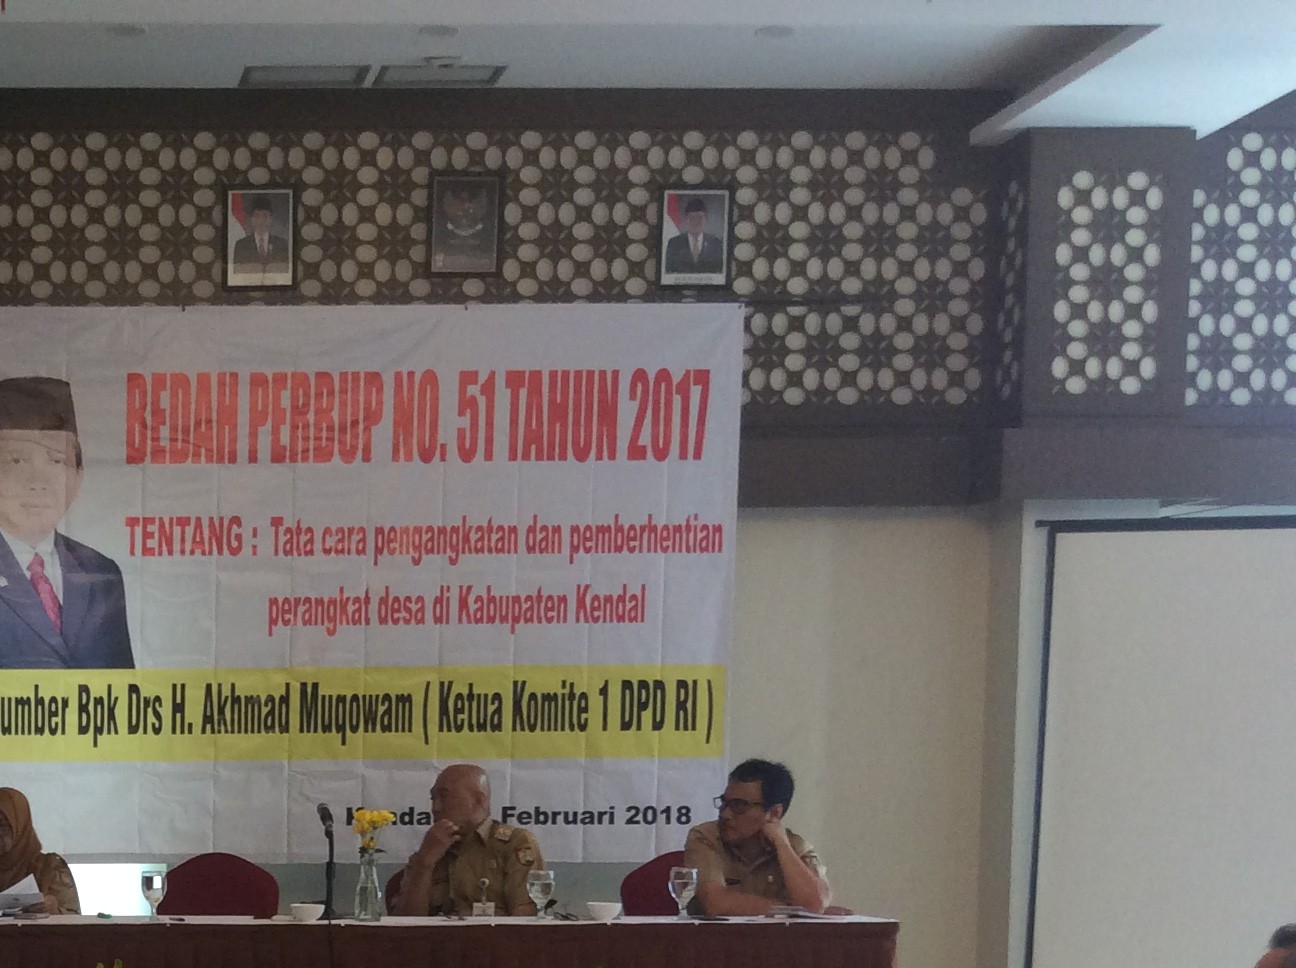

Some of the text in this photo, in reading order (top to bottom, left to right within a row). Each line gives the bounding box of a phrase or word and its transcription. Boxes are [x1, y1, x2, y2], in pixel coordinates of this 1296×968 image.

[125, 367, 711, 466] BEDAH PERBUP NO. 51 TAHUN 2017
[124, 515, 244, 558] TENTANG
[271, 516, 315, 557] Tata
[321, 526, 367, 556] cara
[374, 517, 519, 566] pengangkatan
[525, 516, 562, 555] dan
[569, 513, 724, 564] pemberhentian
[268, 584, 647, 637] perangkat desa di Kabupaten Kendal
[78, 683, 120, 748] Bpk
[127, 683, 164, 737] Drs
[171, 682, 194, 736] H.
[201, 682, 291, 736] Akhmad
[299, 681, 414, 747] Muqowam
[438, 679, 503, 733] Ketua
[511, 679, 590, 733] Komite
[599, 679, 610, 732] 1
[620, 679, 666, 732] DPD
[674, 679, 698, 732] RI
[501, 806, 615, 826] Februari
[624, 805, 692, 827] 2018
